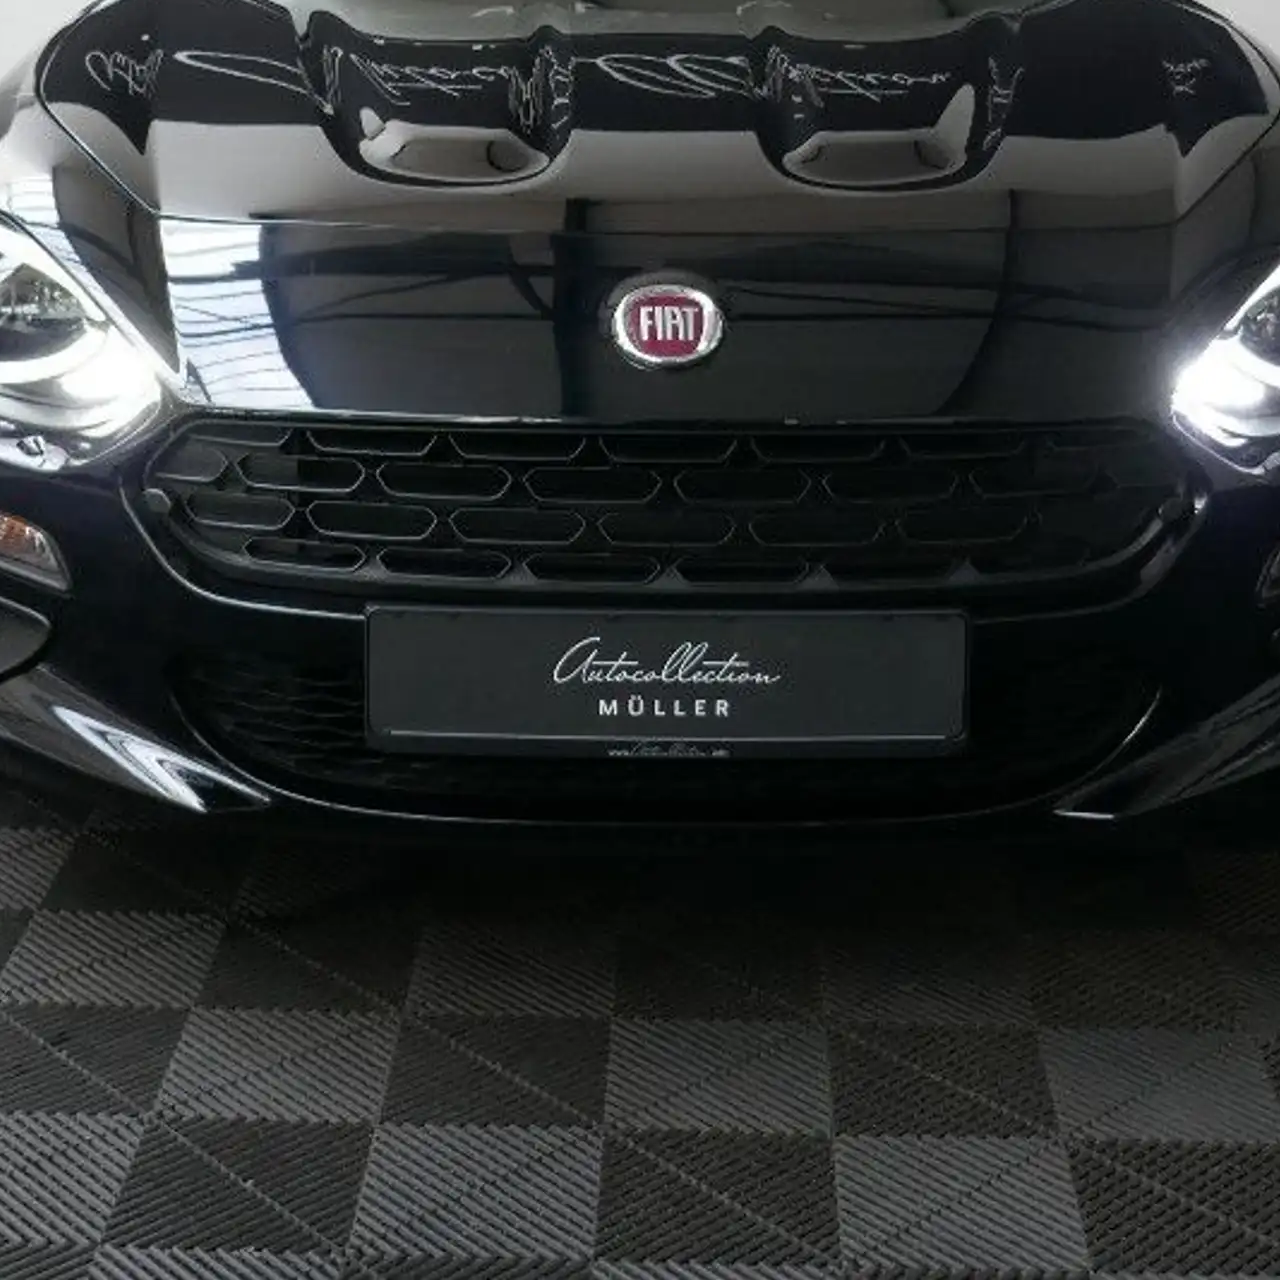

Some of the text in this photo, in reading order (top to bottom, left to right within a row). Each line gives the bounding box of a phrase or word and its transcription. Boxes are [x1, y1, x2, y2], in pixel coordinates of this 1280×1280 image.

[639, 305, 699, 341] FIAT
[552, 635, 782, 685] Autocollection
[598, 694, 731, 718] MÜLLER
